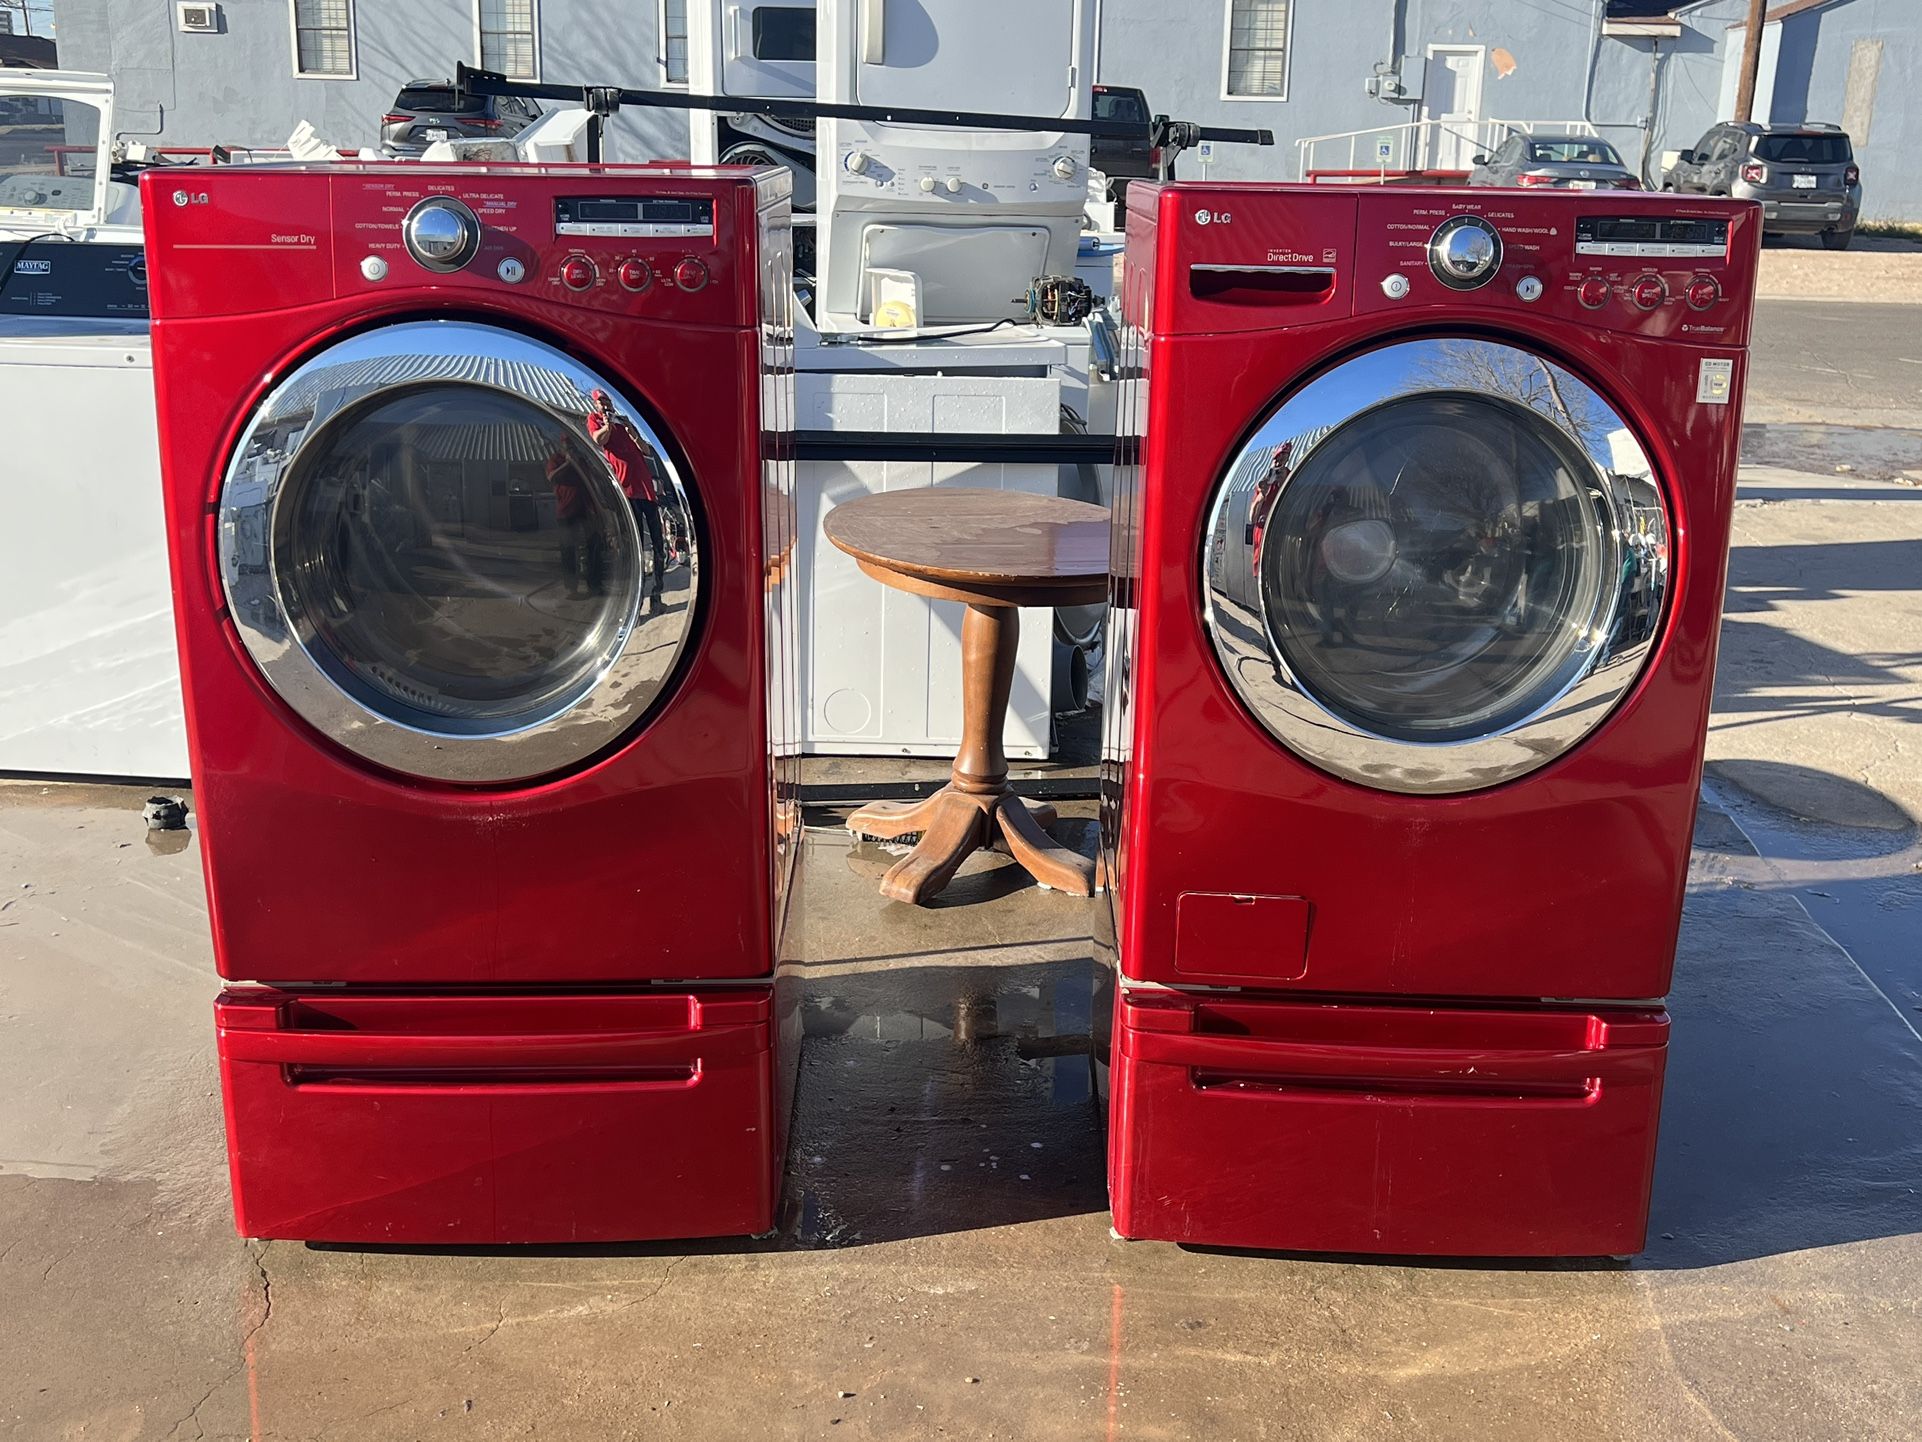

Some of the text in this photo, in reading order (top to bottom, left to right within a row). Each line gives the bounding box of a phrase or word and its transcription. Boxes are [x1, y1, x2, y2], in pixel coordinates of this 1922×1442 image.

[191, 193, 208, 204] LG
[1213, 212, 1231, 223] LG
[271, 234, 315, 245] Sensor Dry
[1267, 253, 1314, 262] Direct Drive
[16, 262, 48, 270] MAYTAG
